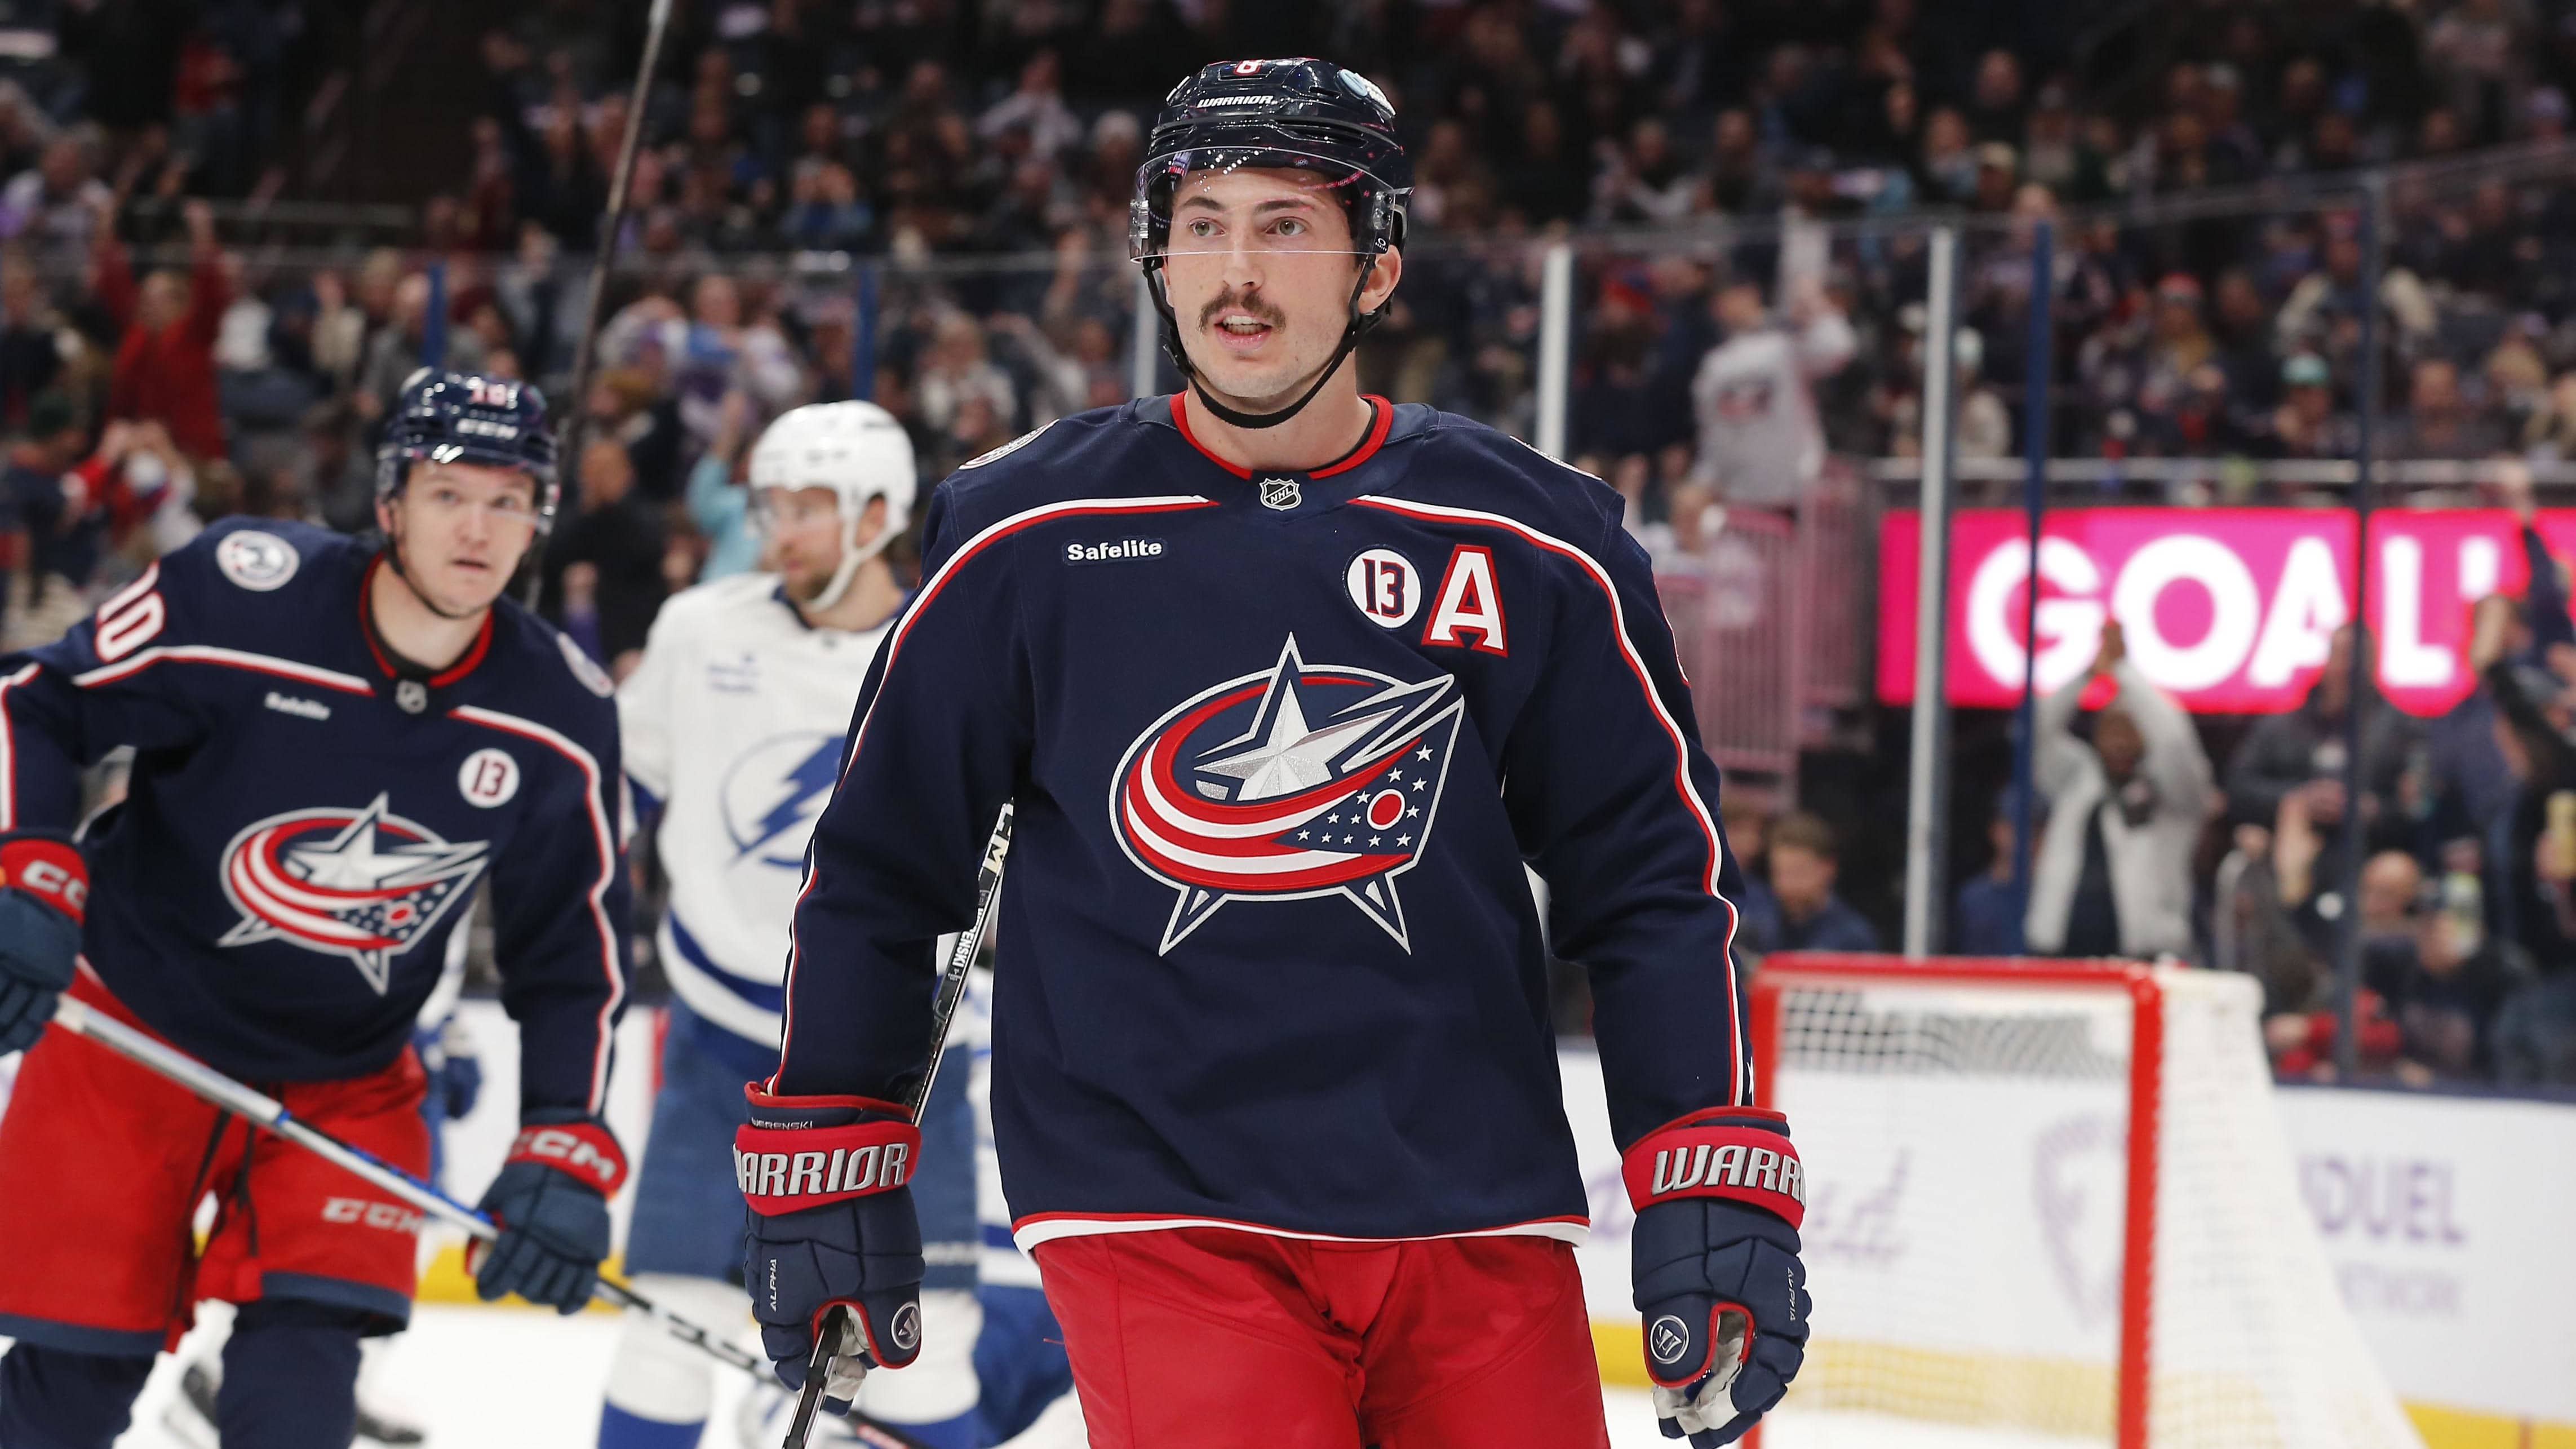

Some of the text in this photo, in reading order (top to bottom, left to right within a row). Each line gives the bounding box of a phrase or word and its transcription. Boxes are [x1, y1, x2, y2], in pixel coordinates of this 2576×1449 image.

[1196, 95, 1274, 108] WARRIOR
[1270, 488, 1293, 504] NHL
[1067, 539, 1163, 561] Safelite
[1363, 559, 1405, 619] 13
[1421, 544, 1508, 658] A
[471, 756, 507, 797] 13
[1787, 1266, 1796, 1321] ALPHA
